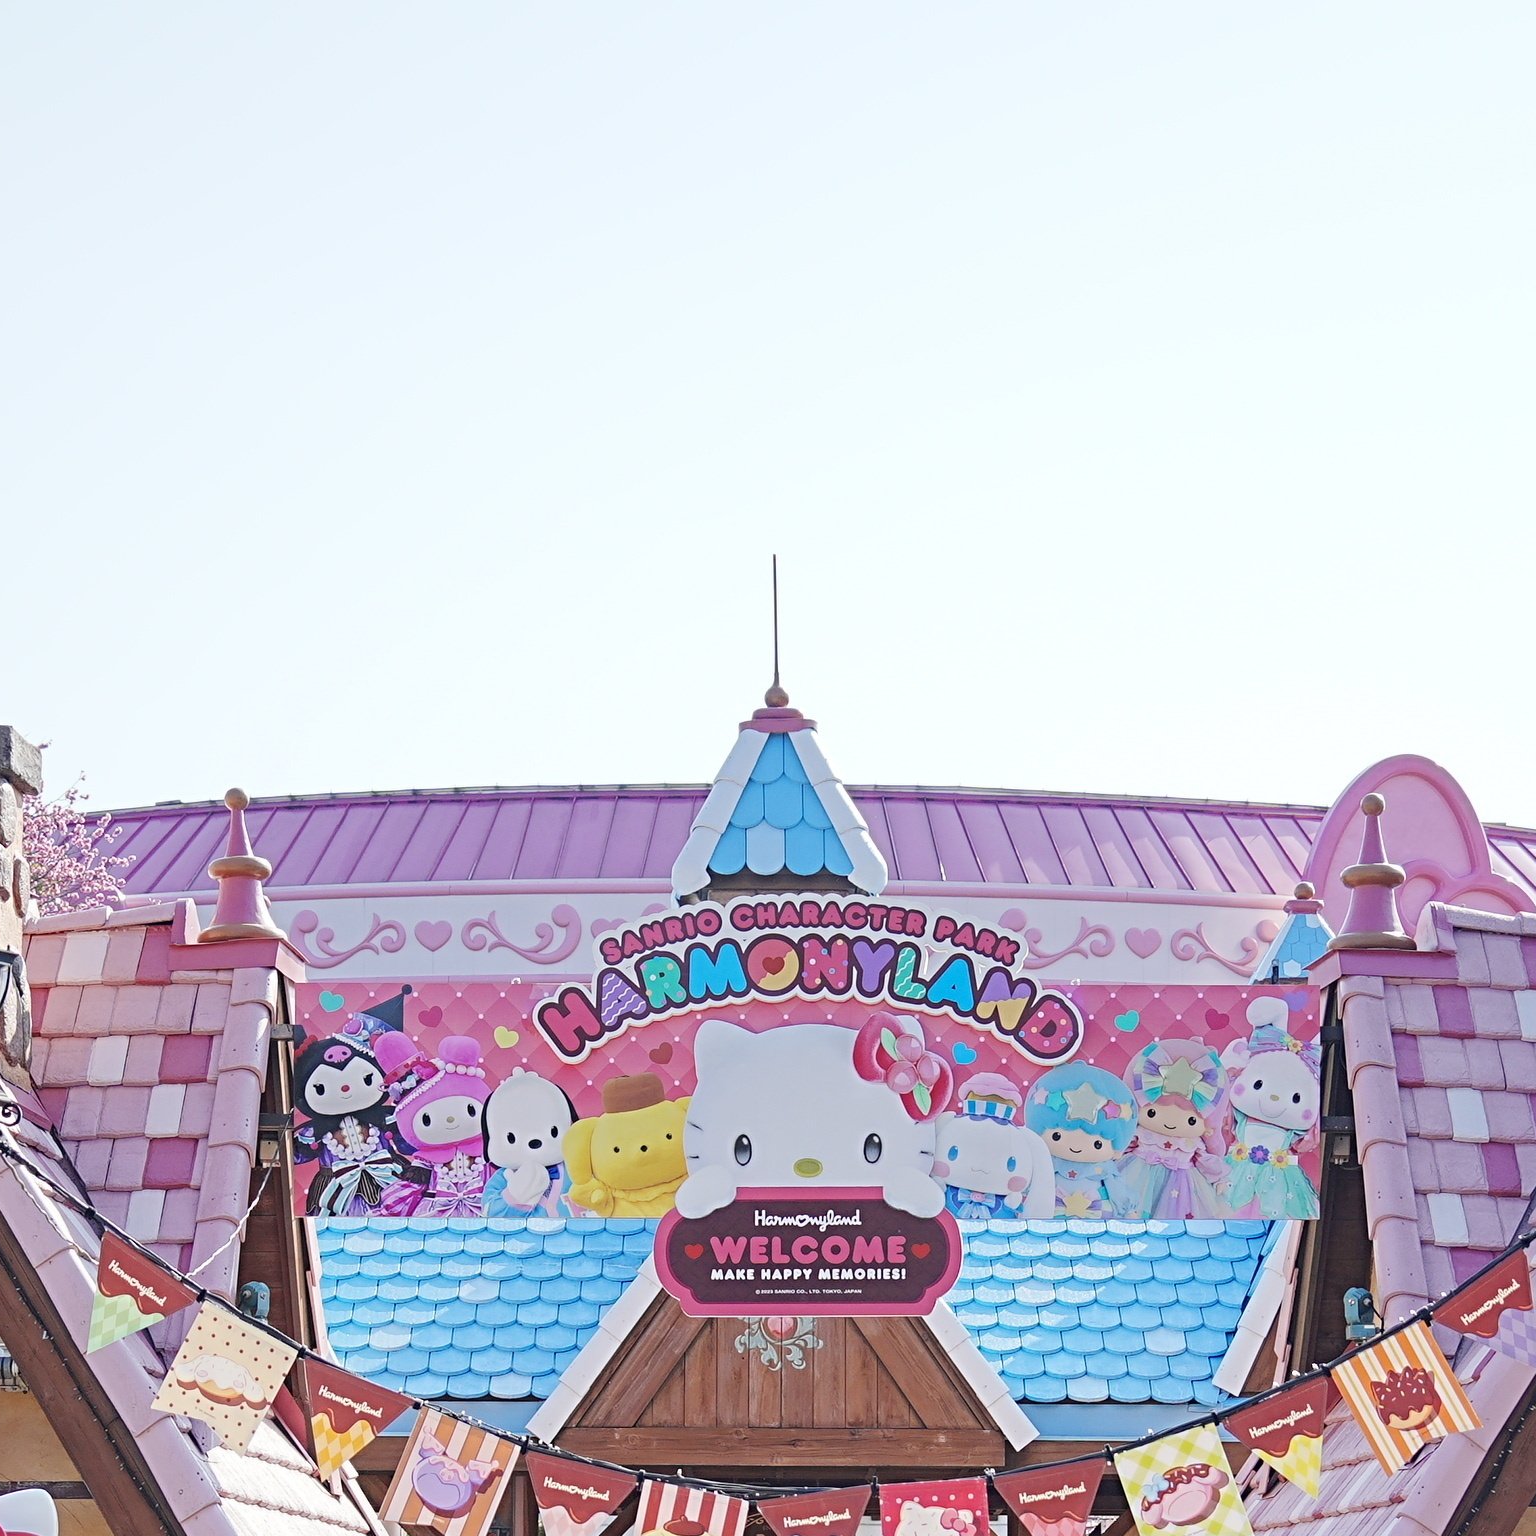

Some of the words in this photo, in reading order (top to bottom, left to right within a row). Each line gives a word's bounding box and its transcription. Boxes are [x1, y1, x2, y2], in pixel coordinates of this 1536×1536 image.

[602, 908, 722, 964] SANRIO
[730, 899, 925, 939] CHARACTER
[934, 914, 1021, 965] PARK
[538, 932, 1077, 1060] HARMONYLAND
[754, 1209, 862, 1232] Harmonyland
[709, 1235, 907, 1265] WELCOME
[108, 1259, 167, 1307] Harmonyland
[710, 1268, 755, 1281] MAKE
[760, 1268, 813, 1281] HAPPY
[817, 1268, 907, 1281] MEMORIES!
[1460, 1278, 1522, 1327] Harmonyland
[318, 1384, 383, 1420] Harmonyland
[1248, 1403, 1315, 1439] Harmonyland
[543, 1475, 611, 1502] Harmonyland
[1018, 1481, 1087, 1505] Harmonyland
[783, 1508, 852, 1529] Harmonyland
